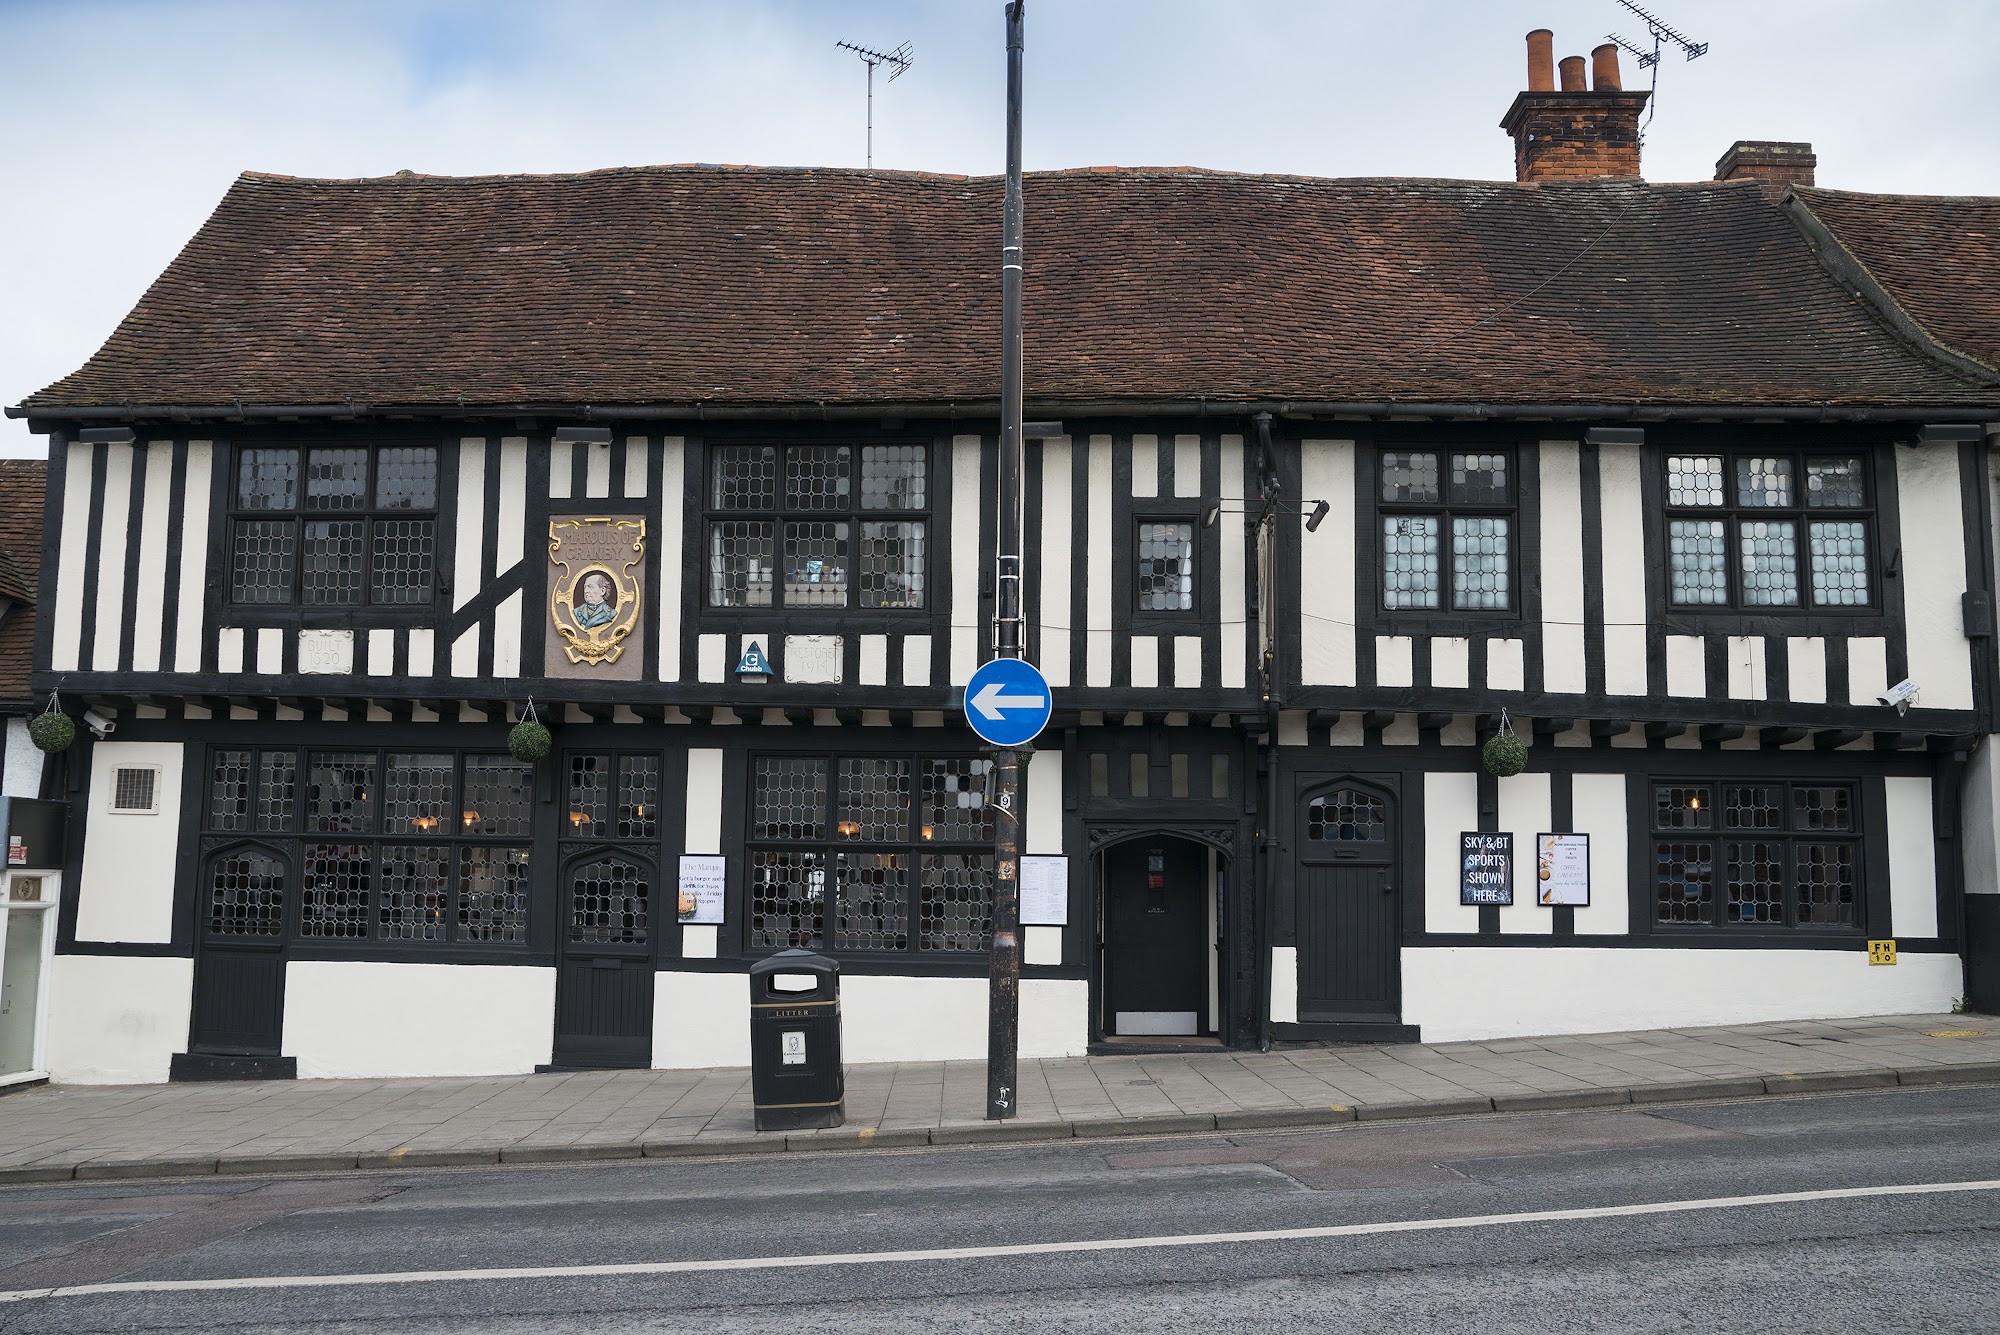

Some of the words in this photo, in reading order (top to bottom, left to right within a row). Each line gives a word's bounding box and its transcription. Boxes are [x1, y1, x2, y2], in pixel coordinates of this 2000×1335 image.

[621, 530, 636, 545] OF
[308, 640, 342, 651] BUILT
[310, 652, 340, 665] 1520
[790, 647, 840, 659] RESTORED
[1002, 796, 1009, 805] 9
[1464, 836, 1484, 849] SKY
[1486, 836, 1495, 849] &
[1497, 837, 1509, 849] BT
[1468, 854, 1506, 867] SPORTS
[1468, 872, 1505, 884] SHOWN
[1473, 889, 1498, 902] HERE
